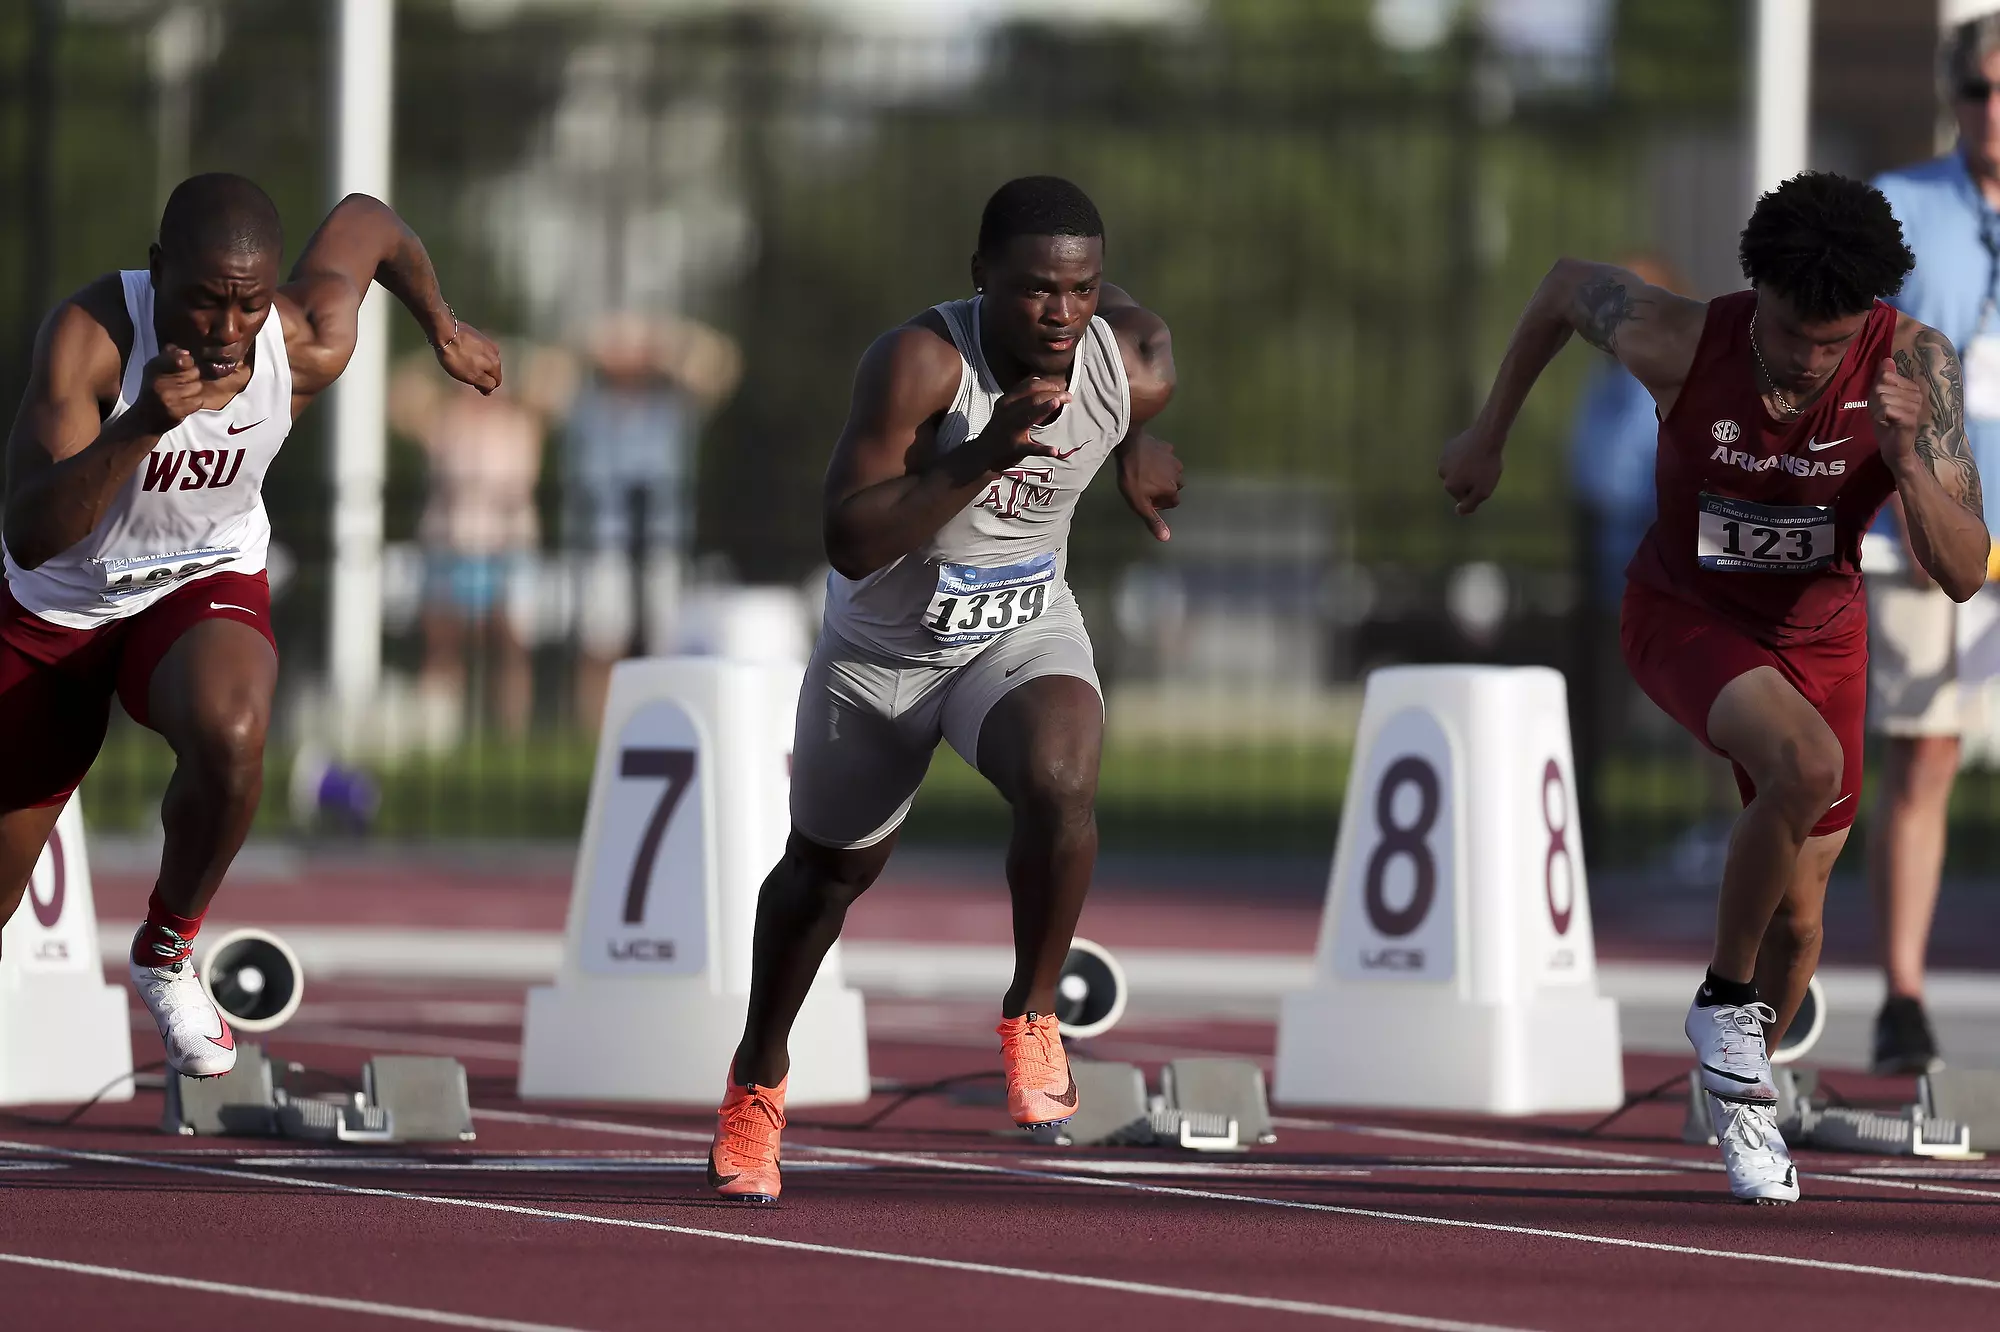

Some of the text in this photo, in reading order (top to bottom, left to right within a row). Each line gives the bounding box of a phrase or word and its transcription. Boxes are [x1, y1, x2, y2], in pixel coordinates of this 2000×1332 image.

[1843, 400, 1868, 409] EQUALI
[1713, 421, 1738, 441] SEC
[142, 448, 247, 492] WSU
[1709, 444, 1847, 478] ARKANSAS
[1722, 506, 1744, 518] TRACK
[1750, 514, 1768, 522] FIELD
[1770, 515, 1828, 525] CHAMPIONSHIPS
[1722, 521, 1813, 560] 123
[1716, 558, 1742, 567] COLLEGE
[962, 583, 981, 592] TRACK
[986, 580, 1004, 589] FIELD
[1003, 569, 1054, 586] CHAMPIONSHIPS
[928, 584, 1045, 632] 1339
[620, 748, 696, 925] 7
[1363, 753, 1441, 939] 8
[1542, 758, 1573, 936] 8
[607, 938, 675, 962] UCS
[1360, 948, 1426, 971] UCS
